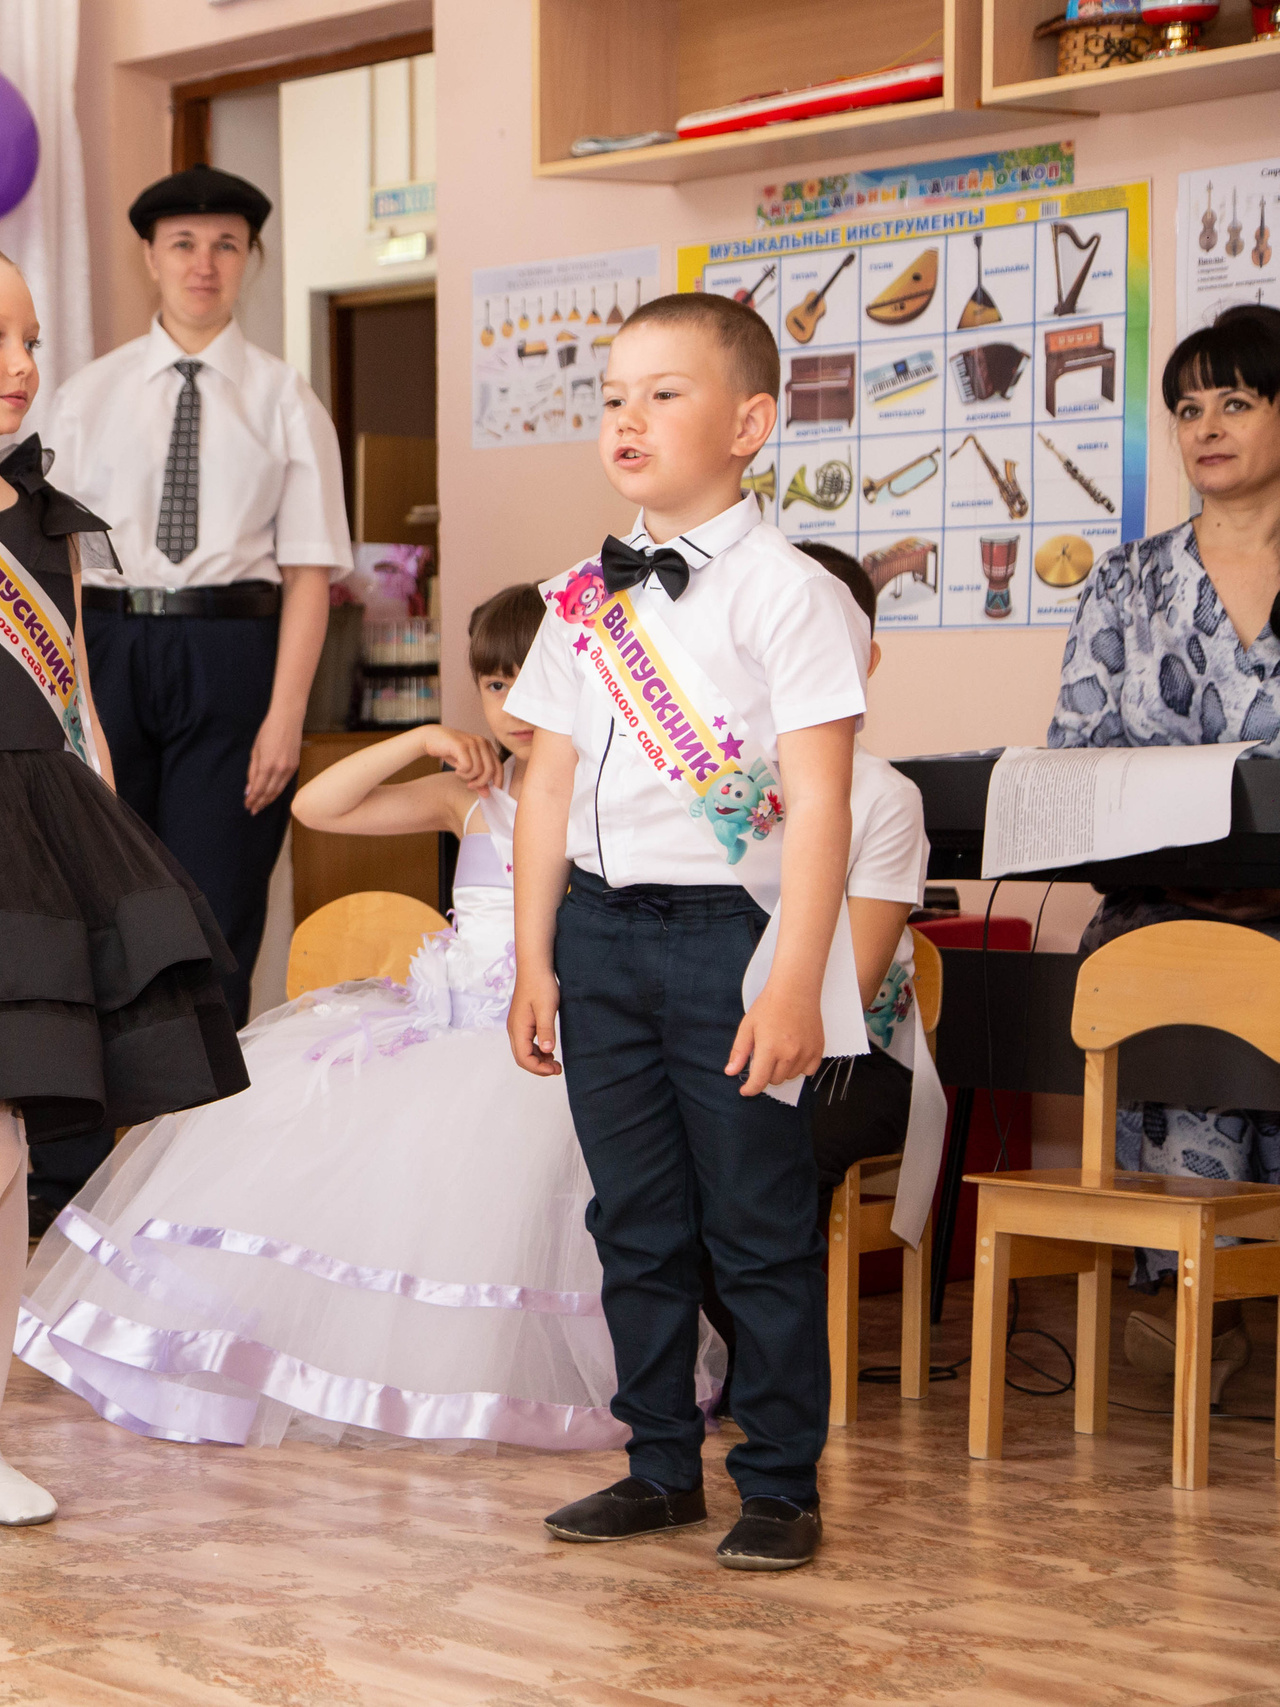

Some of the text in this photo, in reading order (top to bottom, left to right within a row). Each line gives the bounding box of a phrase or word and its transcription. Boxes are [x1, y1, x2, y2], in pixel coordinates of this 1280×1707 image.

[770, 162, 1061, 217] МУЗЫКАЛЬНЫЙ КАЛЕЙДОСКОП
[710, 207, 985, 260] МУЗЫКАЛЬНЫЕ ИНСТРУМЕНТЫ
[20, 646, 47, 688] сада
[600, 601, 720, 783] ВЫПУСКНИК
[589, 645, 667, 772] детского сада
